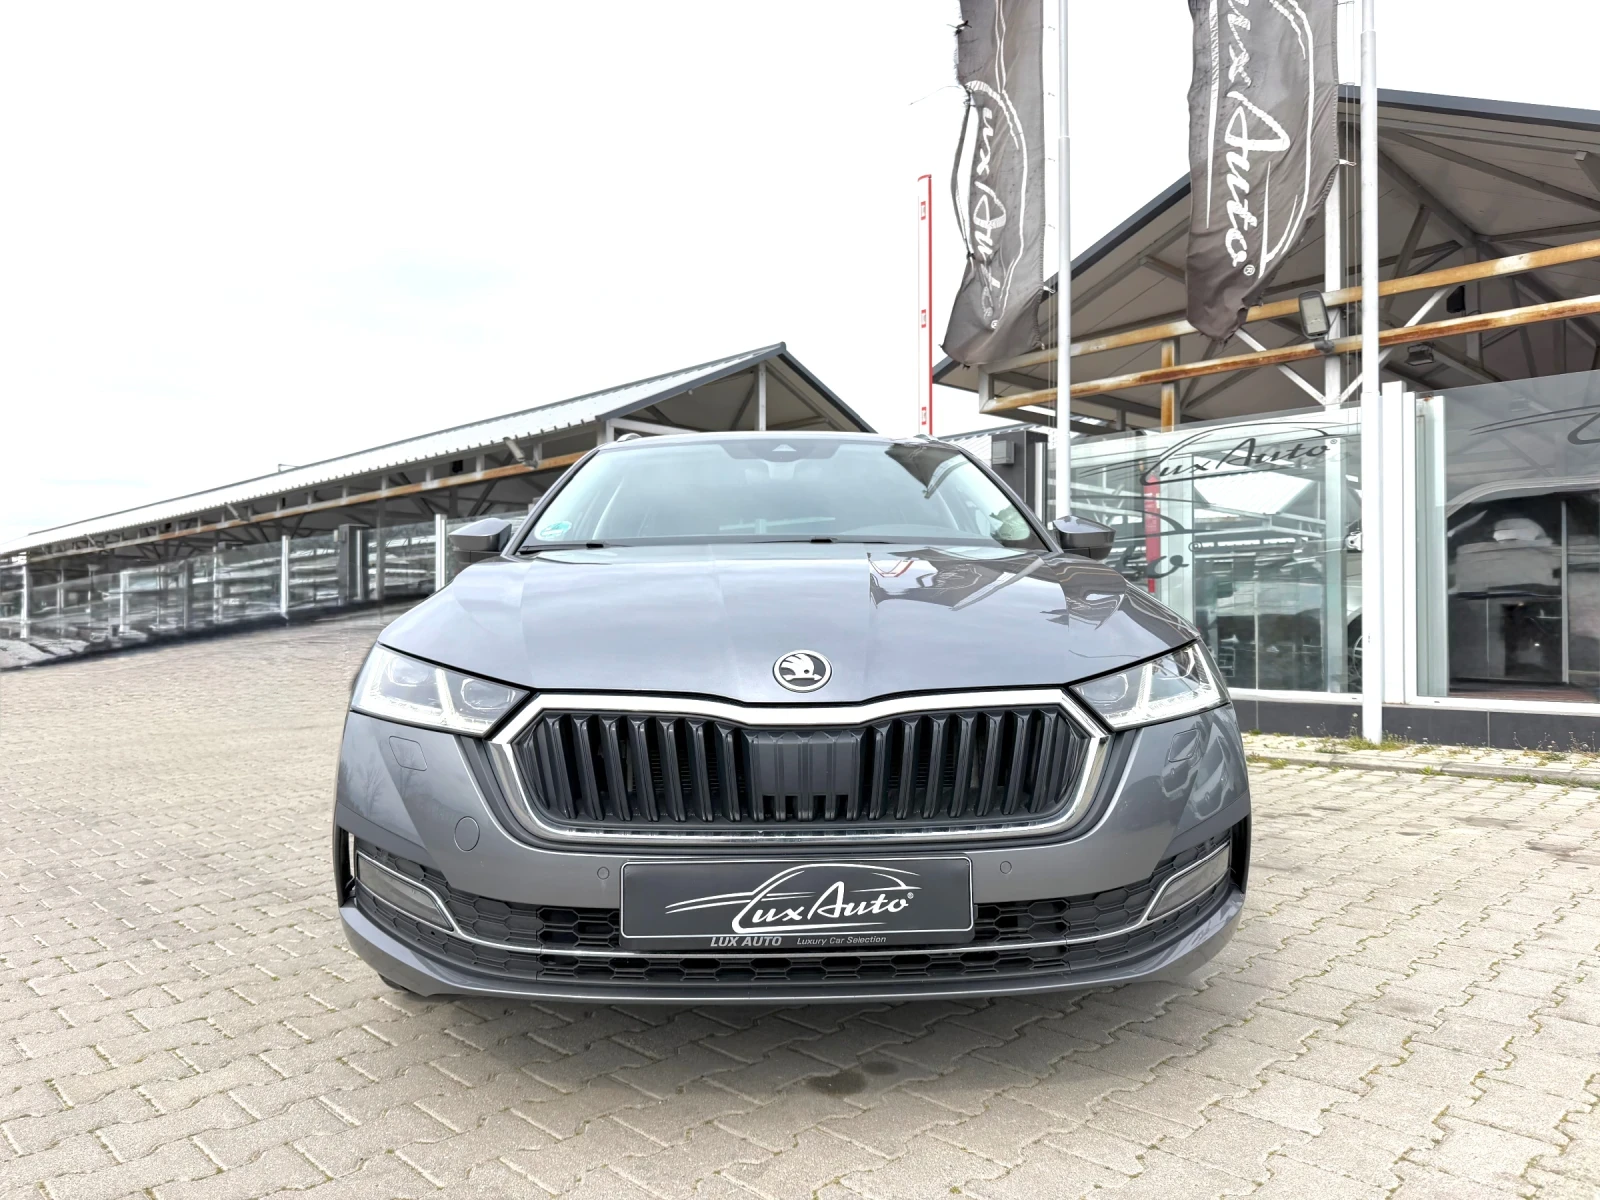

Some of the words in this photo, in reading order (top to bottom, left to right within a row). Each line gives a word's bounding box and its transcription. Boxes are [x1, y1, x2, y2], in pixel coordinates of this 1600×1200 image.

[710, 936, 740, 947] LUX
[741, 936, 782, 947] AUTO
[796, 937, 828, 946] Luxury
[829, 936, 845, 945] Car
[846, 935, 887, 945] Selection
